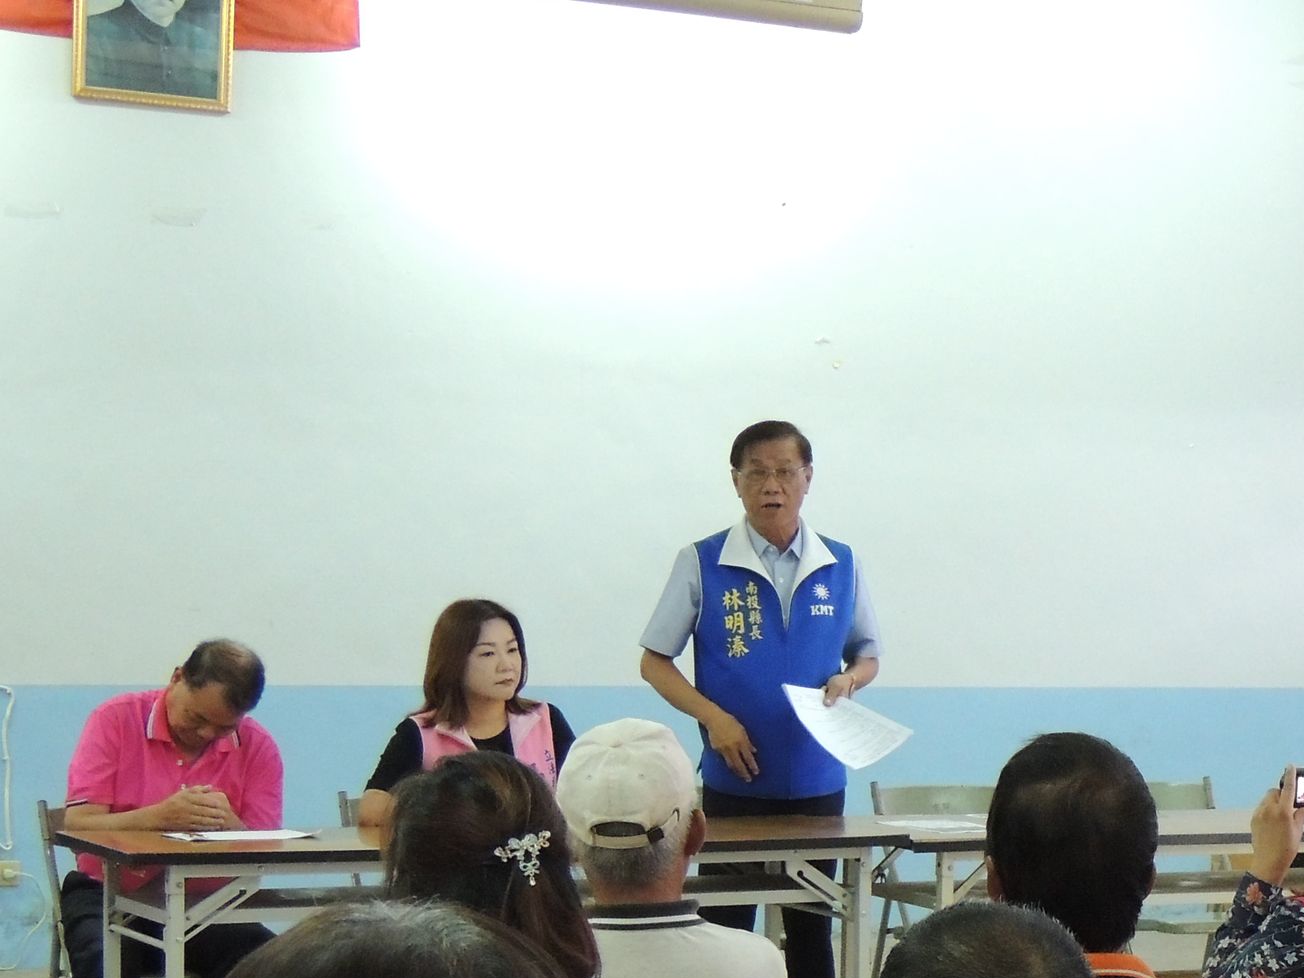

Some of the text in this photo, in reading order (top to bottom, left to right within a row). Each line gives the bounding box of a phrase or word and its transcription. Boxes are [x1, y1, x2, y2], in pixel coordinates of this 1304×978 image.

[722, 588, 749, 658] 林明溱
[745, 581, 764, 640] 南投縣長
[810, 605, 835, 616] KMT
